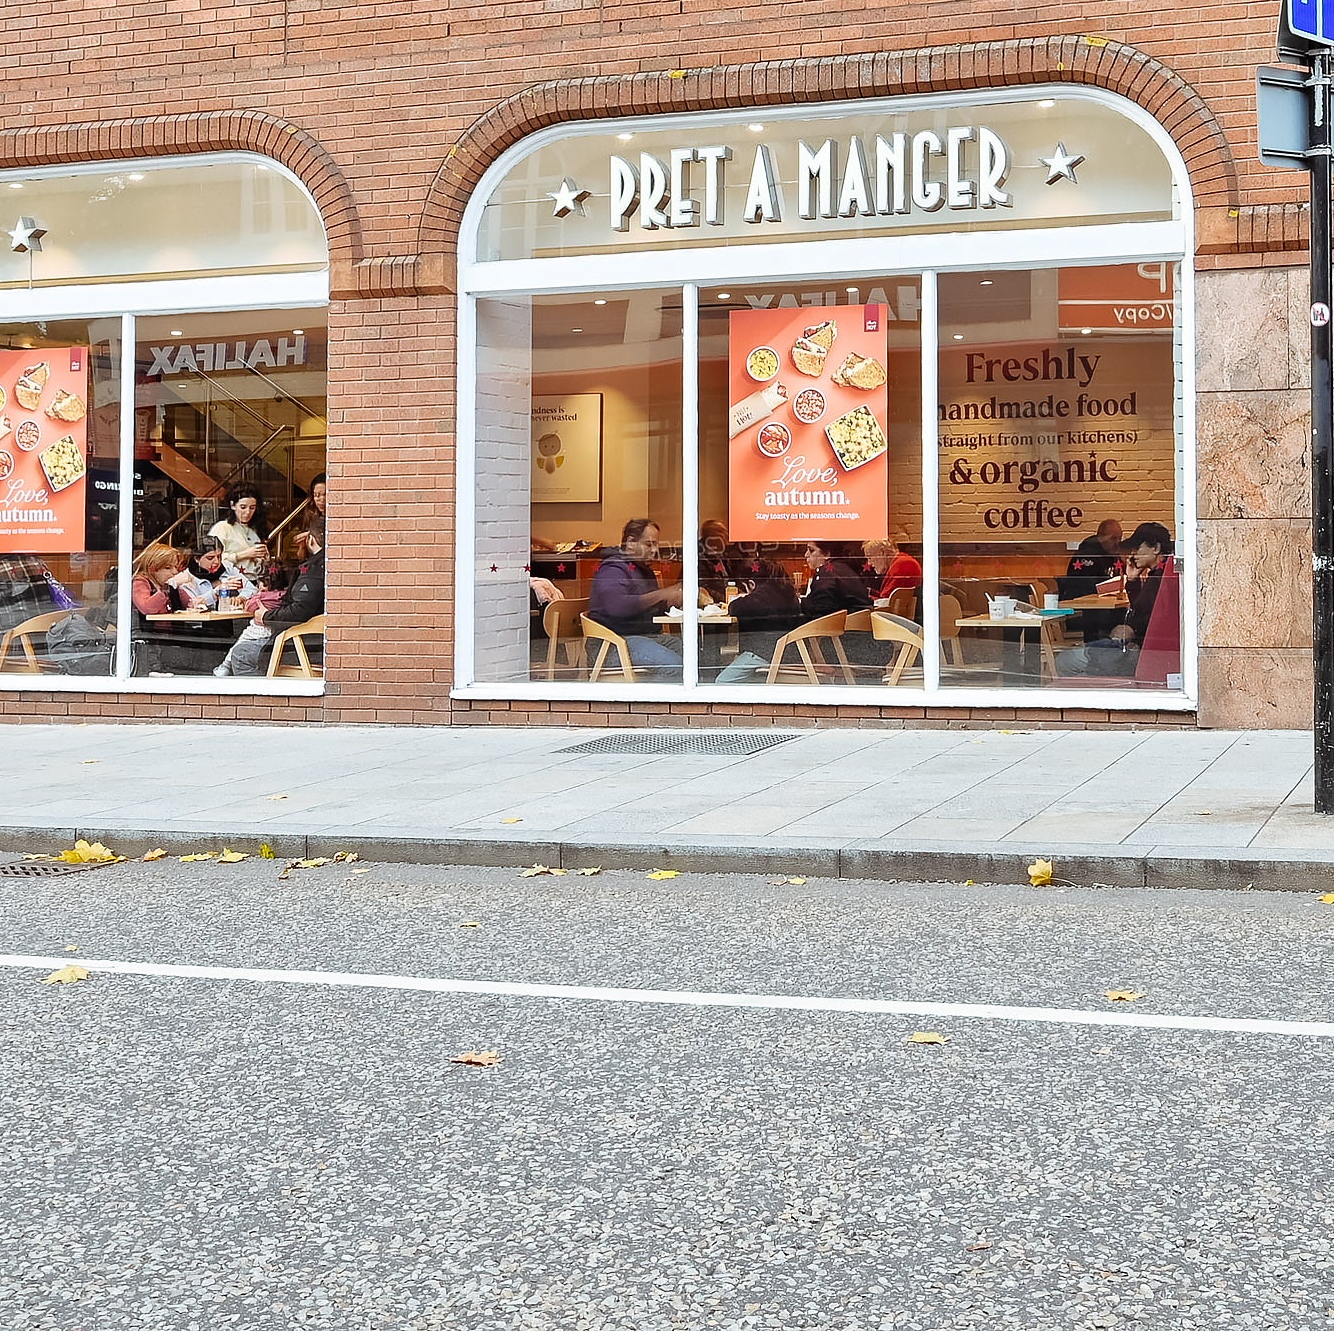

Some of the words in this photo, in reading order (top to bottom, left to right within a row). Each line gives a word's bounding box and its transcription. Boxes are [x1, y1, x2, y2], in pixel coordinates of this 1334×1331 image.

[610, 144, 732, 232] PRET
[798, 125, 1014, 221] MANGER
[965, 347, 1101, 387] Freshly
[531, 406, 557, 414] ndness
[552, 413, 578, 421] wasted
[1076, 392, 1137, 417] food
[938, 432, 995, 450] straight
[997, 431, 1033, 446] from
[1036, 433, 1064, 445] our
[1067, 430, 1138, 445] kitchens)
[771, 455, 838, 489] Love,
[979, 450, 1119, 493] organic
[764, 487, 851, 506] autumn.
[755, 512, 769, 521] Stay
[770, 512, 790, 521] toasty
[799, 511, 809, 519] the
[983, 499, 1083, 529] coffee
